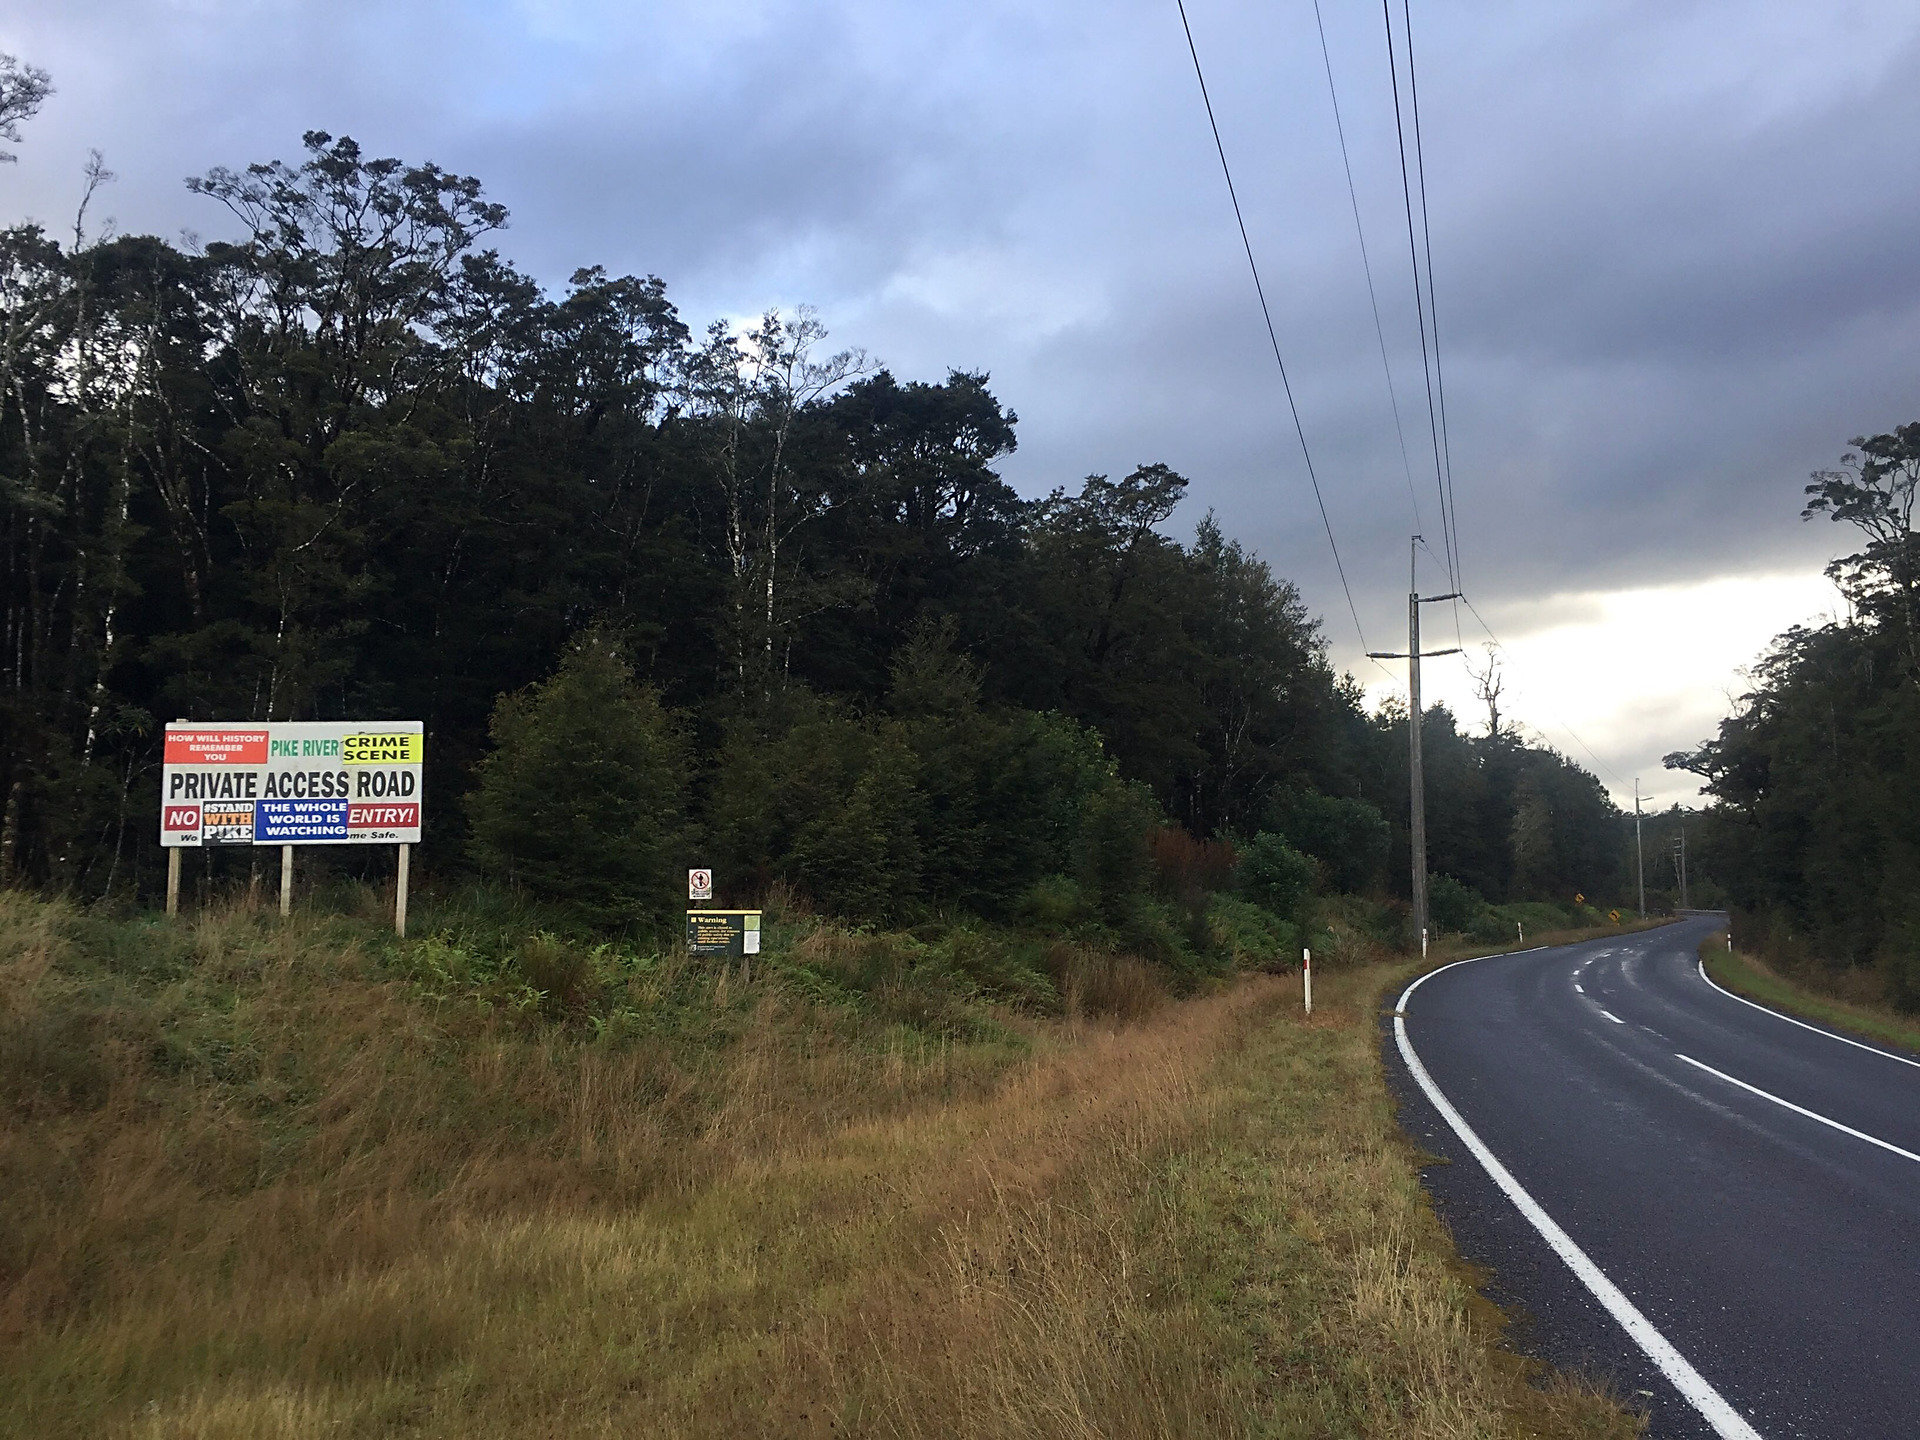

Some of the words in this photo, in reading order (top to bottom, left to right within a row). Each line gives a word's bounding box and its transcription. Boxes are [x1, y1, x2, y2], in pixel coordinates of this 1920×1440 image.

[344, 737, 410, 747] CRIME
[189, 744, 243, 752] REMEMBER
[271, 740, 299, 757] PIKE
[303, 739, 339, 757] RIVER
[204, 753, 227, 761] YOU
[343, 750, 410, 761] SCENE
[170, 772, 258, 799] PRIVATE
[264, 771, 349, 799] ACCESS
[356, 771, 415, 798] ROAD
[204, 803, 254, 813] #STAND
[262, 803, 290, 812] THE
[294, 803, 347, 812] WHOLE
[169, 810, 197, 826] NO
[203, 812, 253, 825] WITH
[268, 815, 323, 824] WORLD
[326, 814, 340, 823] IS
[348, 808, 414, 823] ENTRY!
[203, 825, 253, 839] PIKE
[266, 826, 347, 836] WATCHING
[371, 831, 399, 839] Safe.
